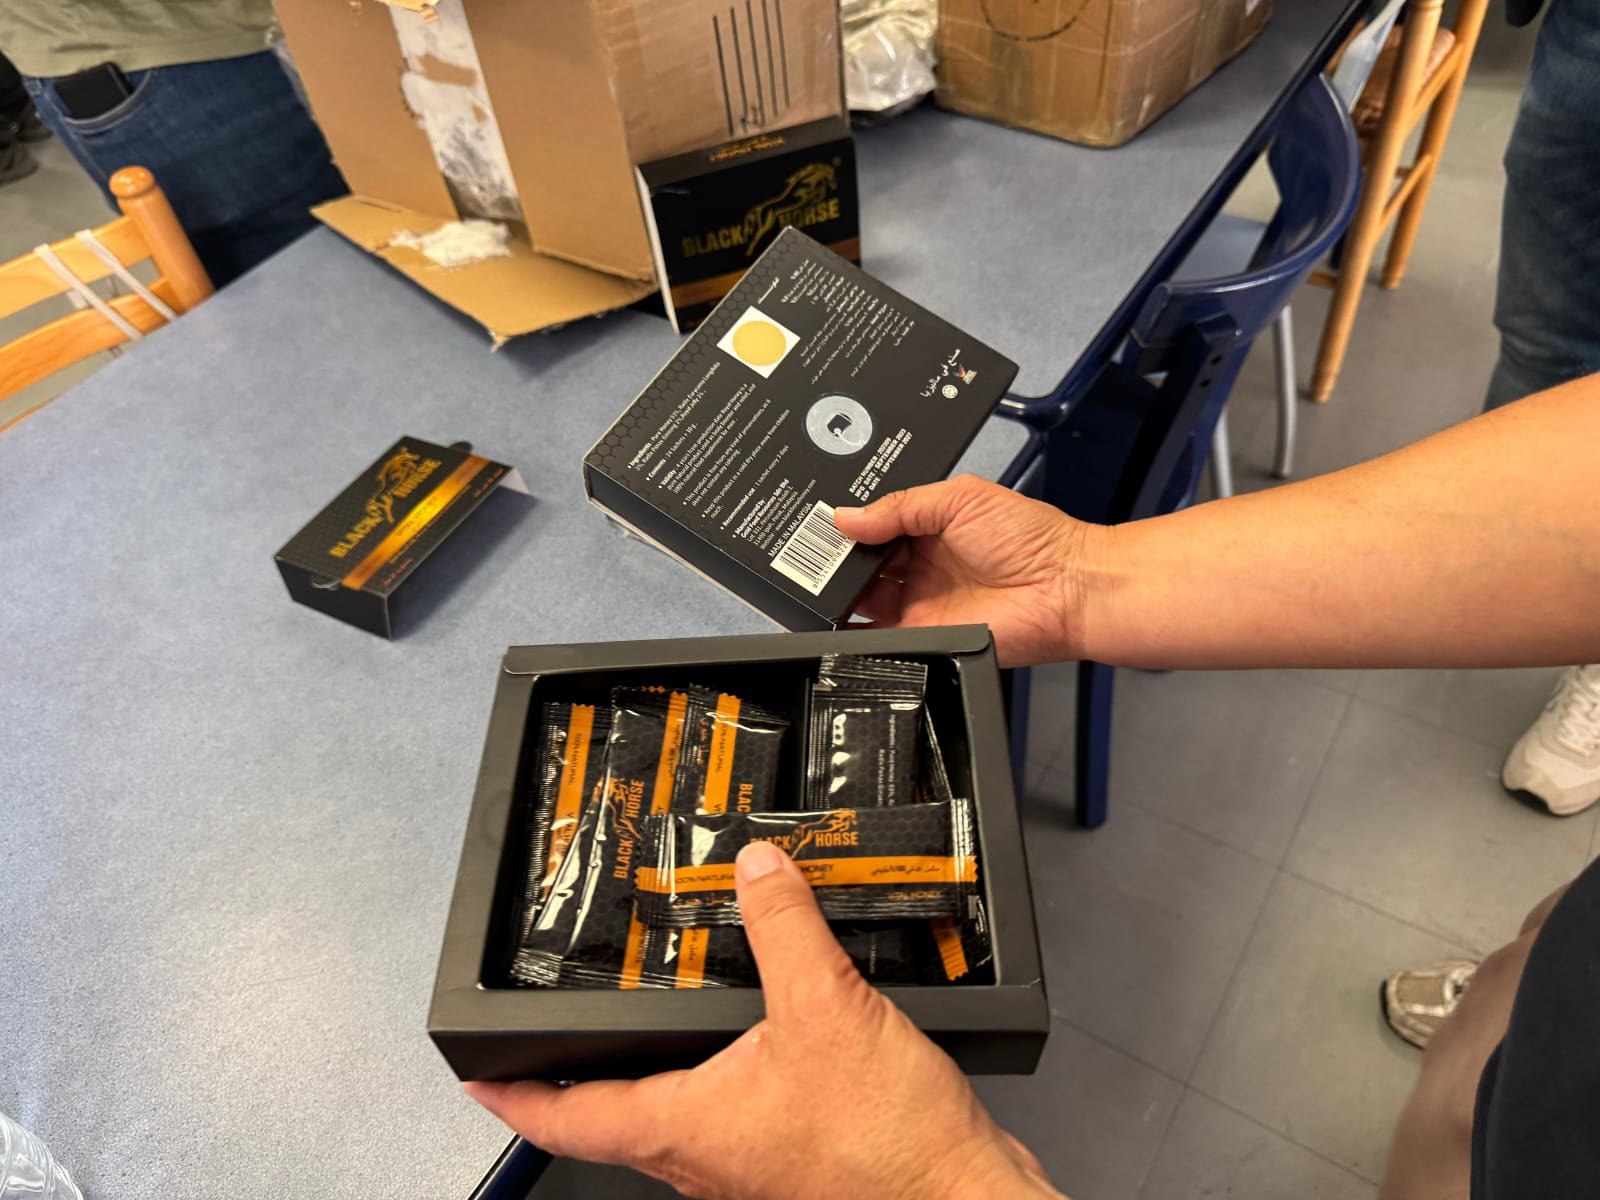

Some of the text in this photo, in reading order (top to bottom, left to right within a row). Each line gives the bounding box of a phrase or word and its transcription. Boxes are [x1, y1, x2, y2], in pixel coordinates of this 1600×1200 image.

[681, 199, 840, 257] BLACK HORSE
[918, 346, 965, 399] صنع في ماليزيا
[628, 441, 652, 466] Ingredients
[853, 427, 907, 497] MFG DATE SEPTEMBER 2023
[859, 489, 871, 501] EXP
[867, 476, 881, 491] DATE
[880, 442, 905, 473] SEPTEMBER
[659, 468, 677, 486] Validity
[847, 474, 864, 493] BATCH
[859, 454, 879, 477] NUMBER
[330, 510, 386, 558] BLACK
[395, 459, 442, 498] HORSE
[721, 494, 749, 527] Recommended
[734, 503, 760, 534] Manufactured
[739, 525, 752, 539] Gold
[747, 514, 761, 528] Food
[767, 500, 813, 558] MADE IN MALAYSIA
[737, 783, 753, 813] BLAC
[613, 780, 645, 879] BLACK HORSE
[815, 832, 859, 847] HORSE
[696, 873, 735, 882] NATURA
